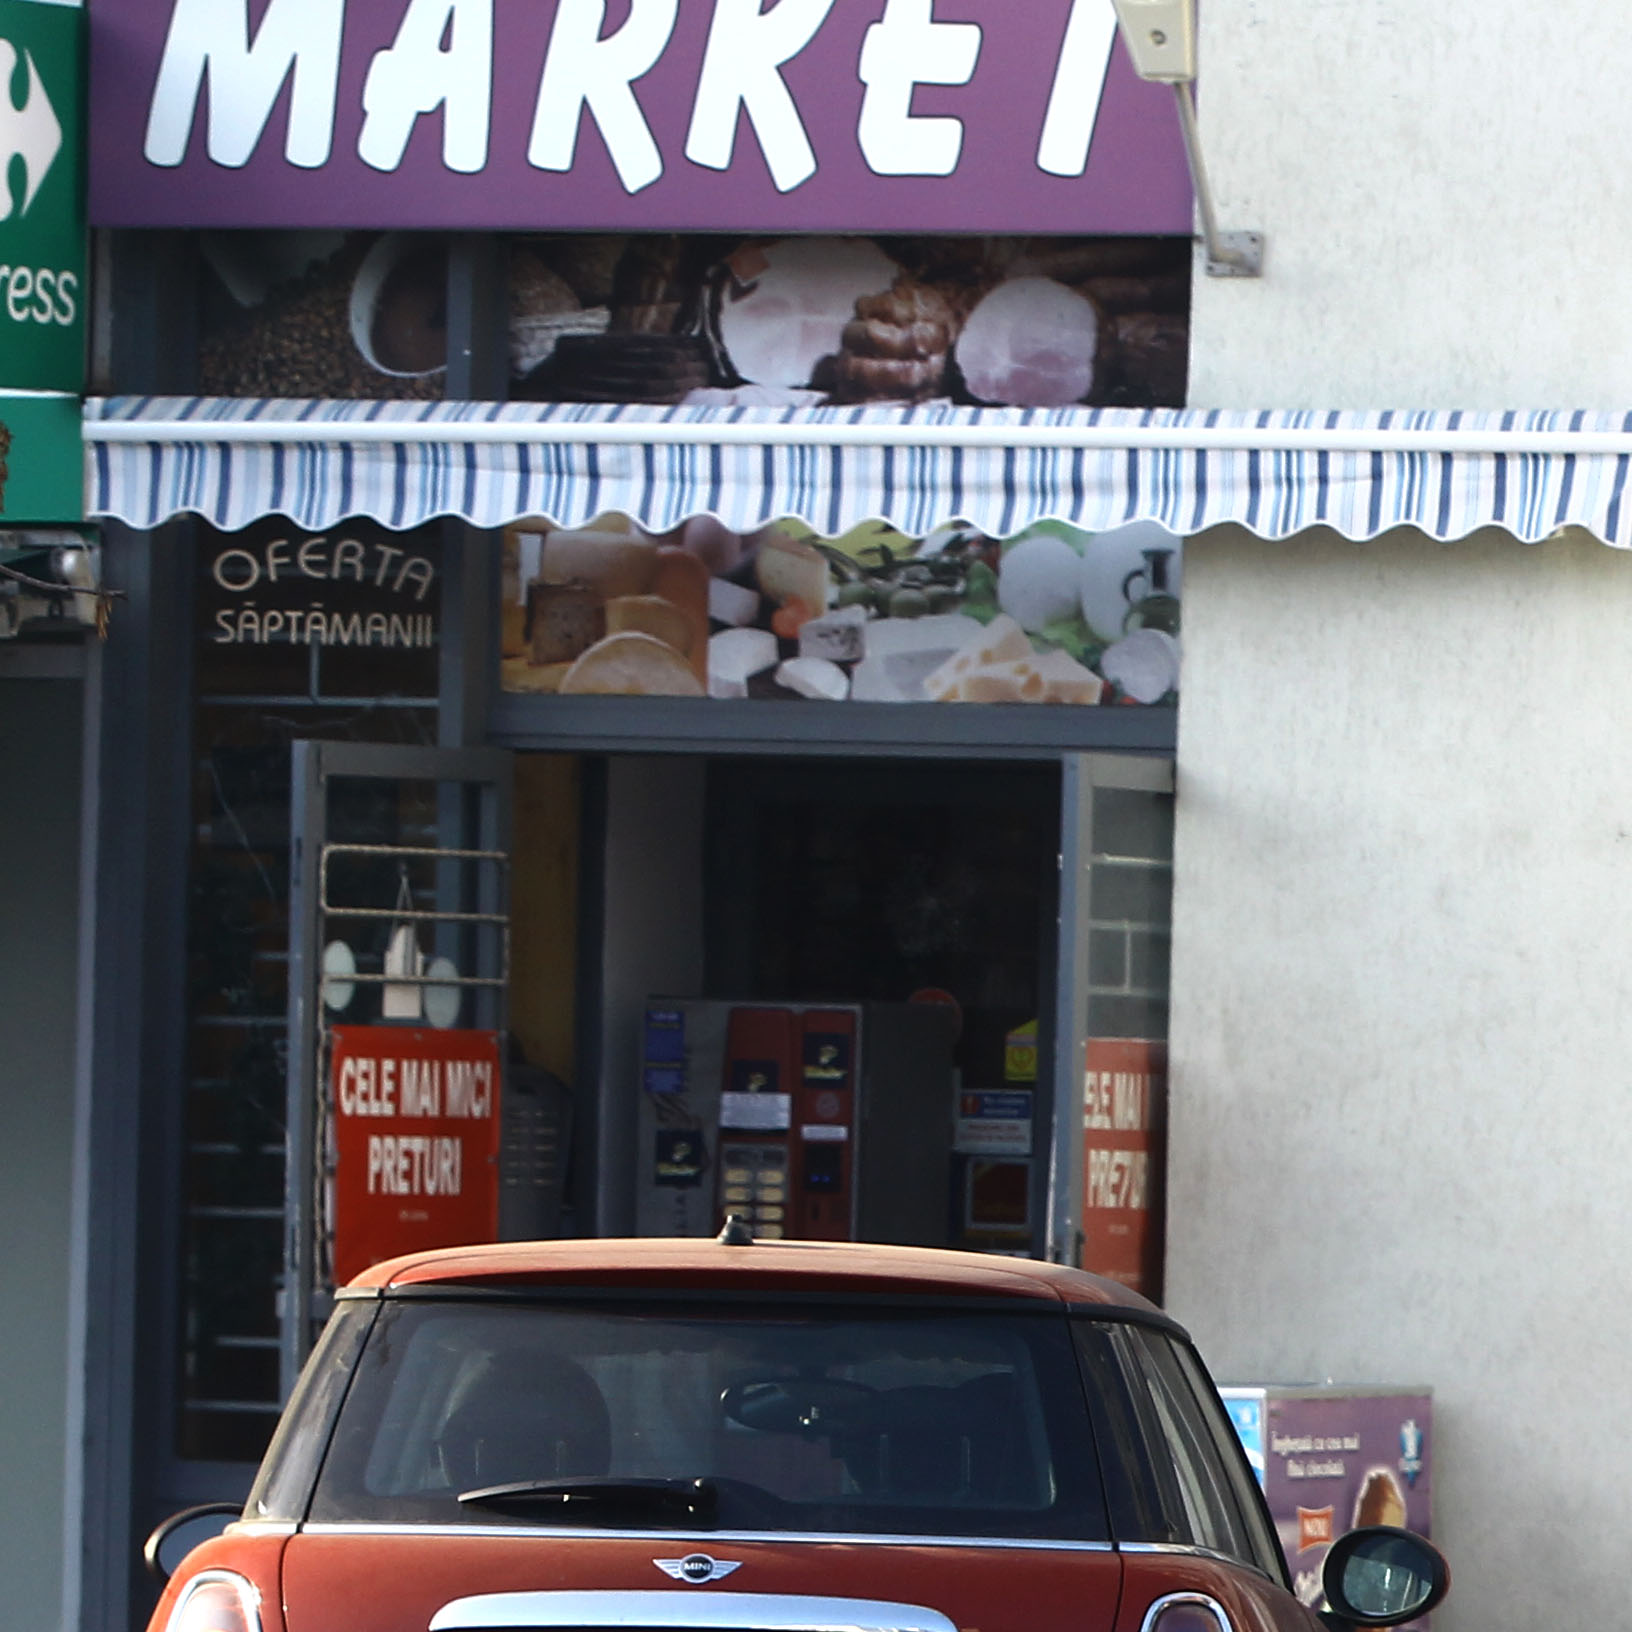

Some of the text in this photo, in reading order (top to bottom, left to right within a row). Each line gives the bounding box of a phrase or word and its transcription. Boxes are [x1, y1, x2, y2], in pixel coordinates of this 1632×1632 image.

[213, 537, 434, 601] OFERTA
[339, 1055, 493, 1120] CELE MAI MICI
[367, 1134, 462, 1196] PRETURI
[683, 1562, 711, 1571] MINI
